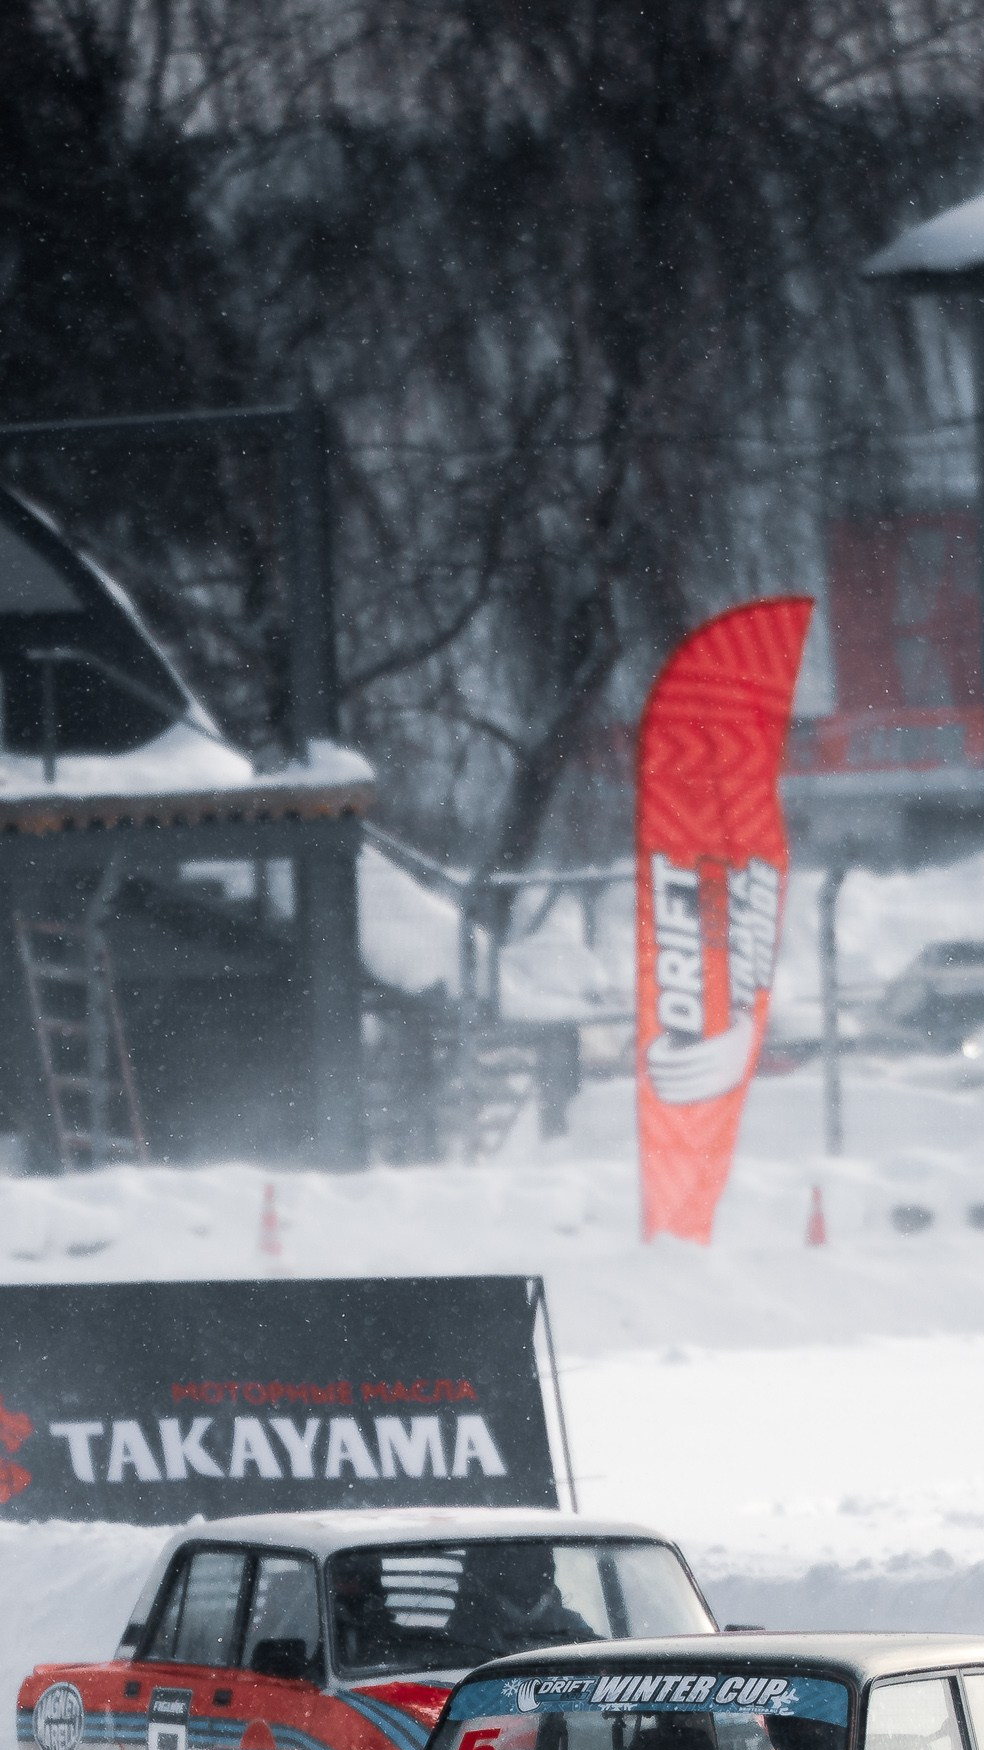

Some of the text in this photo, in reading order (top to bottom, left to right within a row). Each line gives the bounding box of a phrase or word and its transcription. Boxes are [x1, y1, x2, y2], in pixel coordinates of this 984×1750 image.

[652, 853, 702, 1033] DRIFT
[172, 1378, 478, 1405] МОТОРНЫЕ МАСЛА
[49, 1413, 508, 1483] TAKAYAMA
[537, 1679, 597, 1694] DRIFT
[590, 1675, 788, 1706] WINTER CUP
